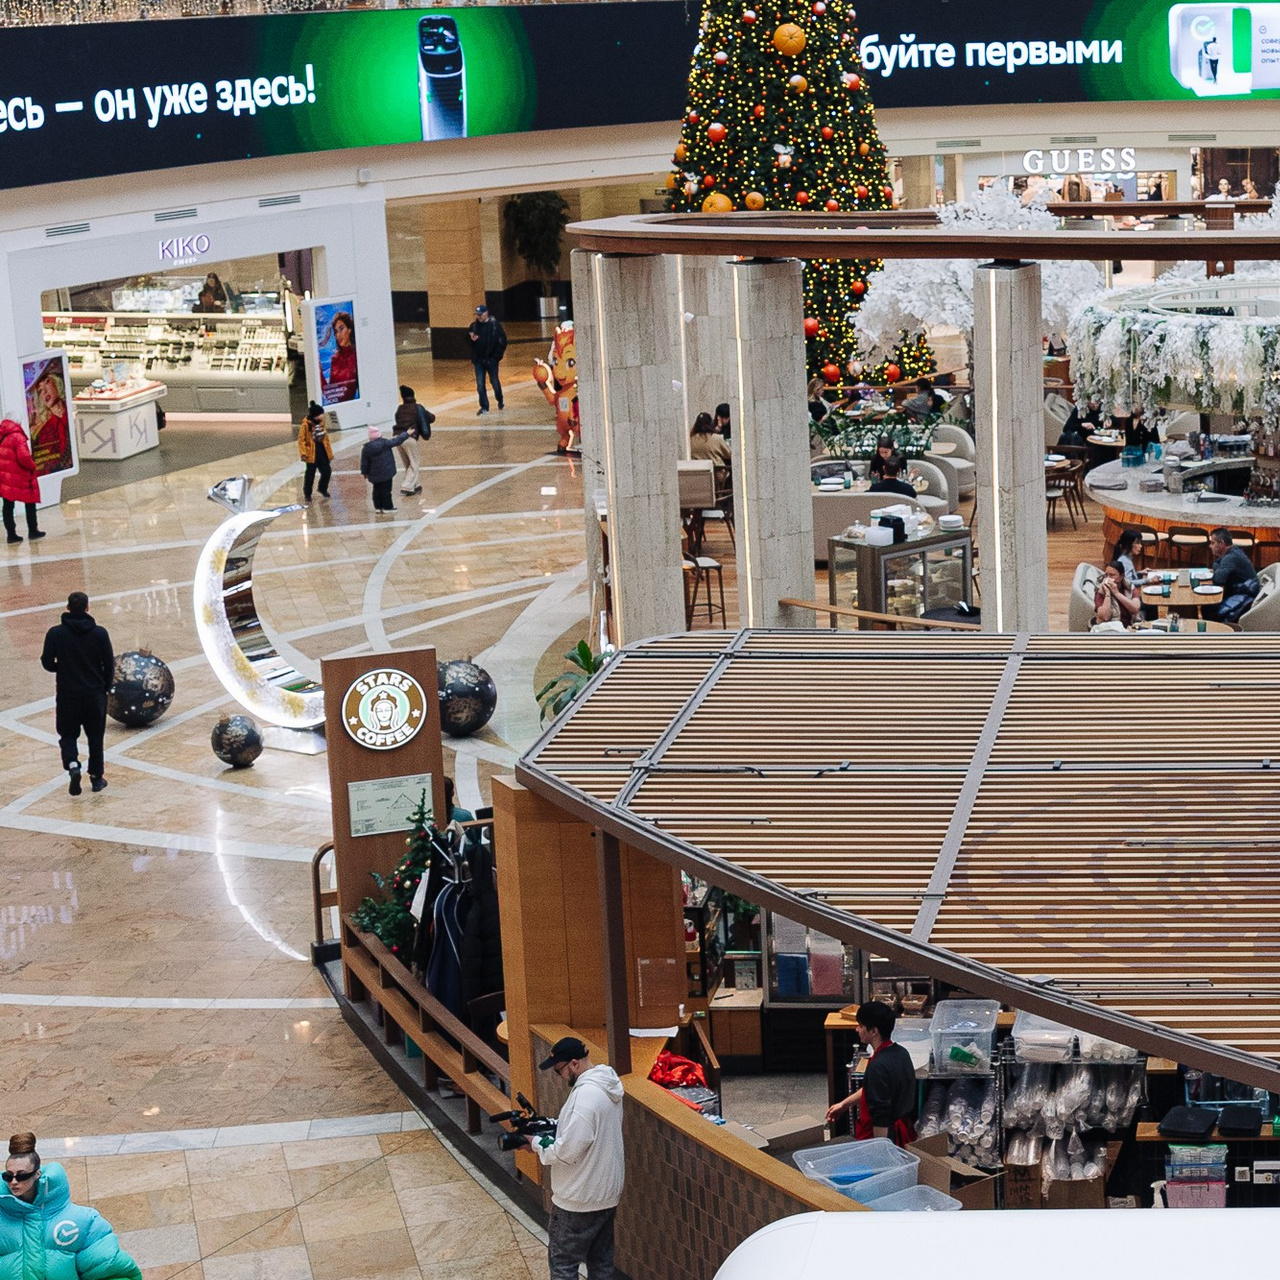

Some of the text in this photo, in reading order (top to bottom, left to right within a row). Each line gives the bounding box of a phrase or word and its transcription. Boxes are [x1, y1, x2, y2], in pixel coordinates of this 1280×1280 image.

[859, 33, 1123, 78] буйте первыми
[94, 87, 137, 122] он
[143, 81, 208, 128] уже
[215, 63, 317, 117] здесь!
[1022, 147, 1137, 174] GUESS
[158, 232, 211, 261] KIKO
[355, 672, 413, 697] STARS
[356, 723, 415, 746] COFFEE
